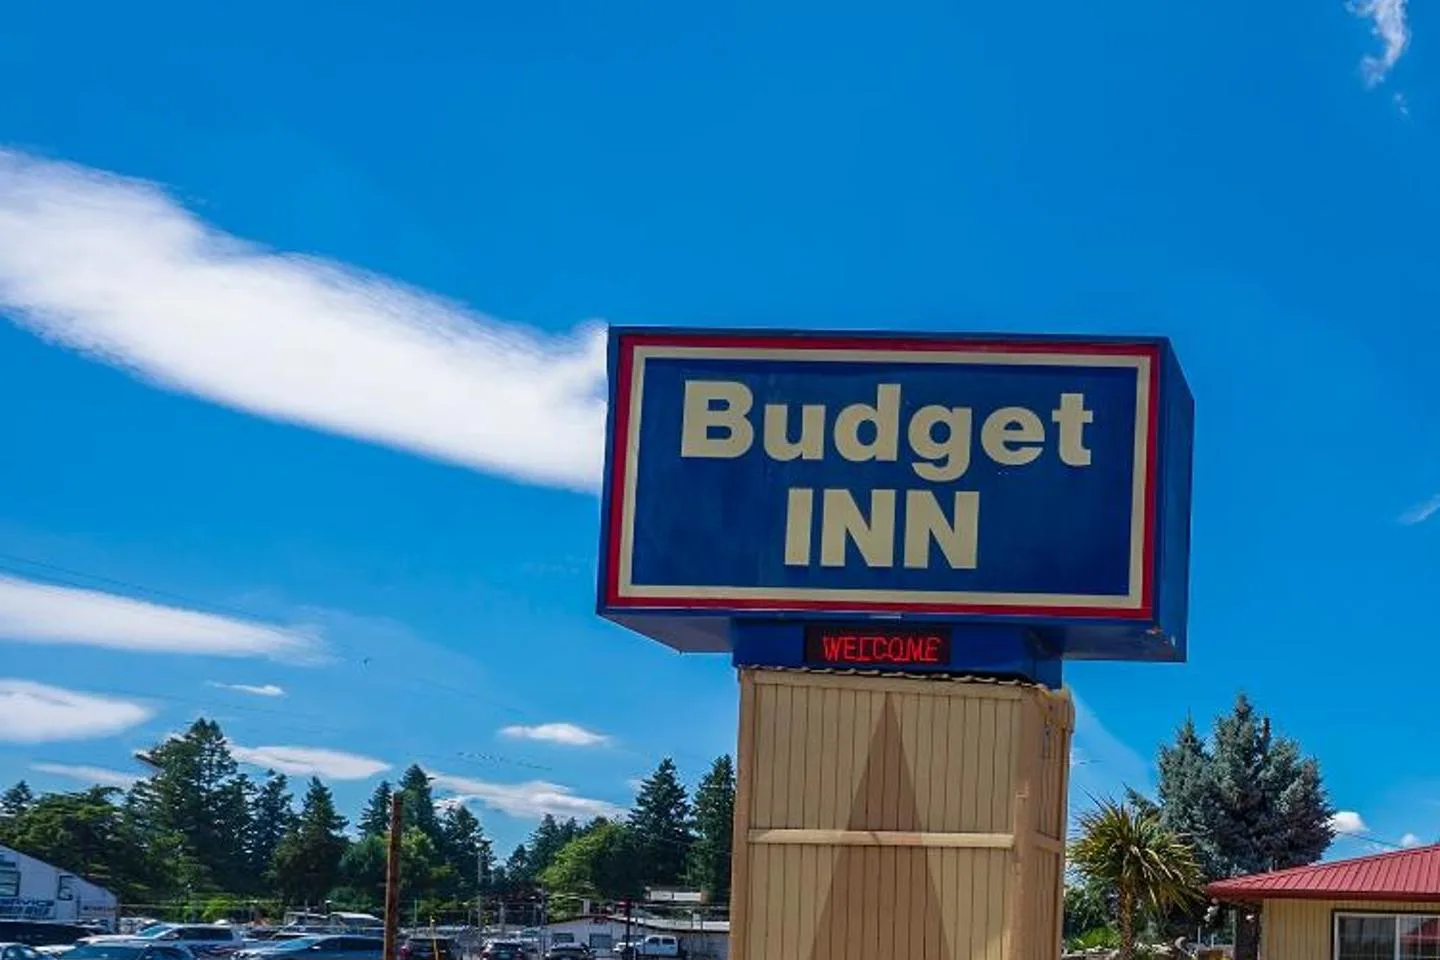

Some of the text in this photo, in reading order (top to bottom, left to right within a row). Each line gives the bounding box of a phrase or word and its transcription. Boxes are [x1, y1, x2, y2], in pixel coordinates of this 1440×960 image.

[680, 379, 1094, 483] Budget
[784, 487, 981, 570] INN
[822, 635, 941, 662] WELCOME
